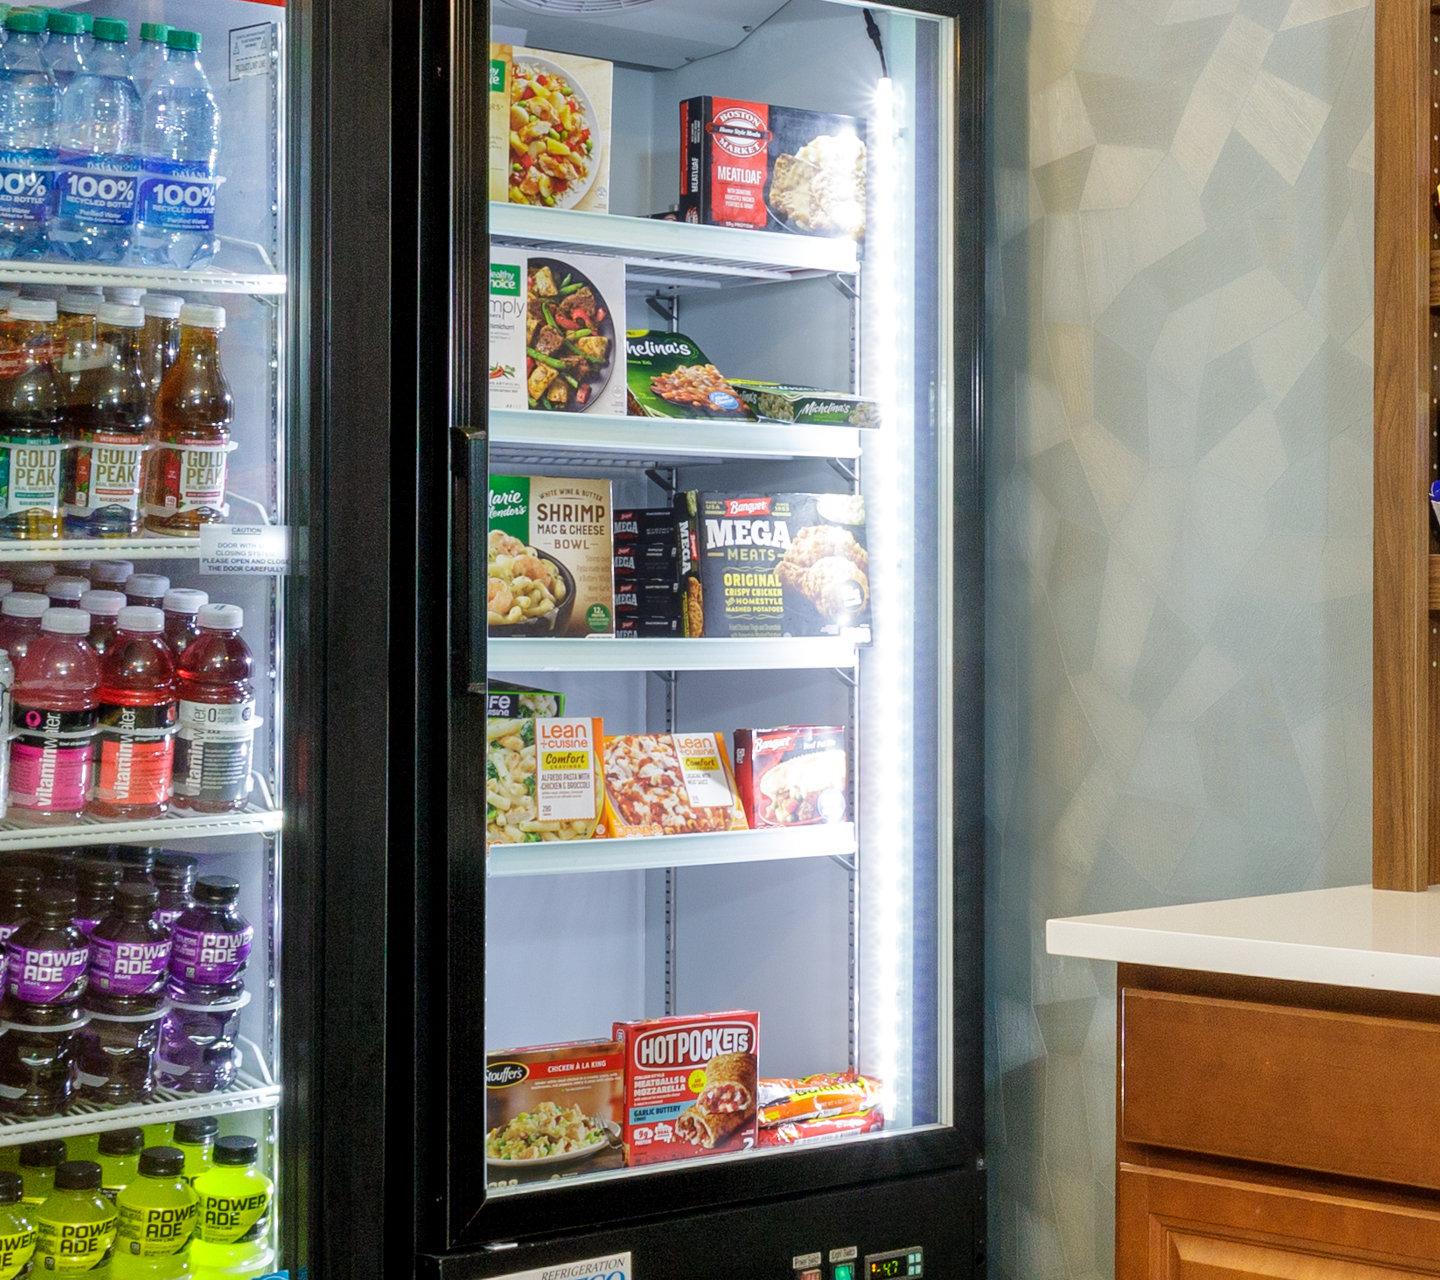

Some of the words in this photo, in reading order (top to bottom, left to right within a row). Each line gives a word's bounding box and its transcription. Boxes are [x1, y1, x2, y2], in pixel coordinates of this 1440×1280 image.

[719, 108, 762, 127] BOSTON
[719, 136, 762, 157] MARKET
[717, 166, 762, 185] MEATLOAF
[801, 402, 851, 415] Michelina's
[537, 504, 605, 522] SHRIMP
[730, 500, 767, 516] Banquet
[538, 524, 557, 535] MAC
[560, 525, 567, 534] &
[570, 525, 604, 535] CHEESE
[705, 519, 792, 549] MEGA
[555, 539, 589, 549] BOWL
[728, 548, 775, 561] MEATS
[724, 572, 782, 588] ORIGINAL
[724, 588, 750, 597] CRISPY
[752, 588, 783, 597] CHICKEN
[736, 597, 783, 605] HOMESTYLE
[542, 725, 587, 739] Lean
[545, 752, 586, 766] Comfort
[26, 949, 88, 968] POWER
[24, 966, 63, 983] ADE
[641, 1033, 677, 1064] HOT
[678, 1028, 748, 1063] POCKETS
[591, 1060, 606, 1068] KING
